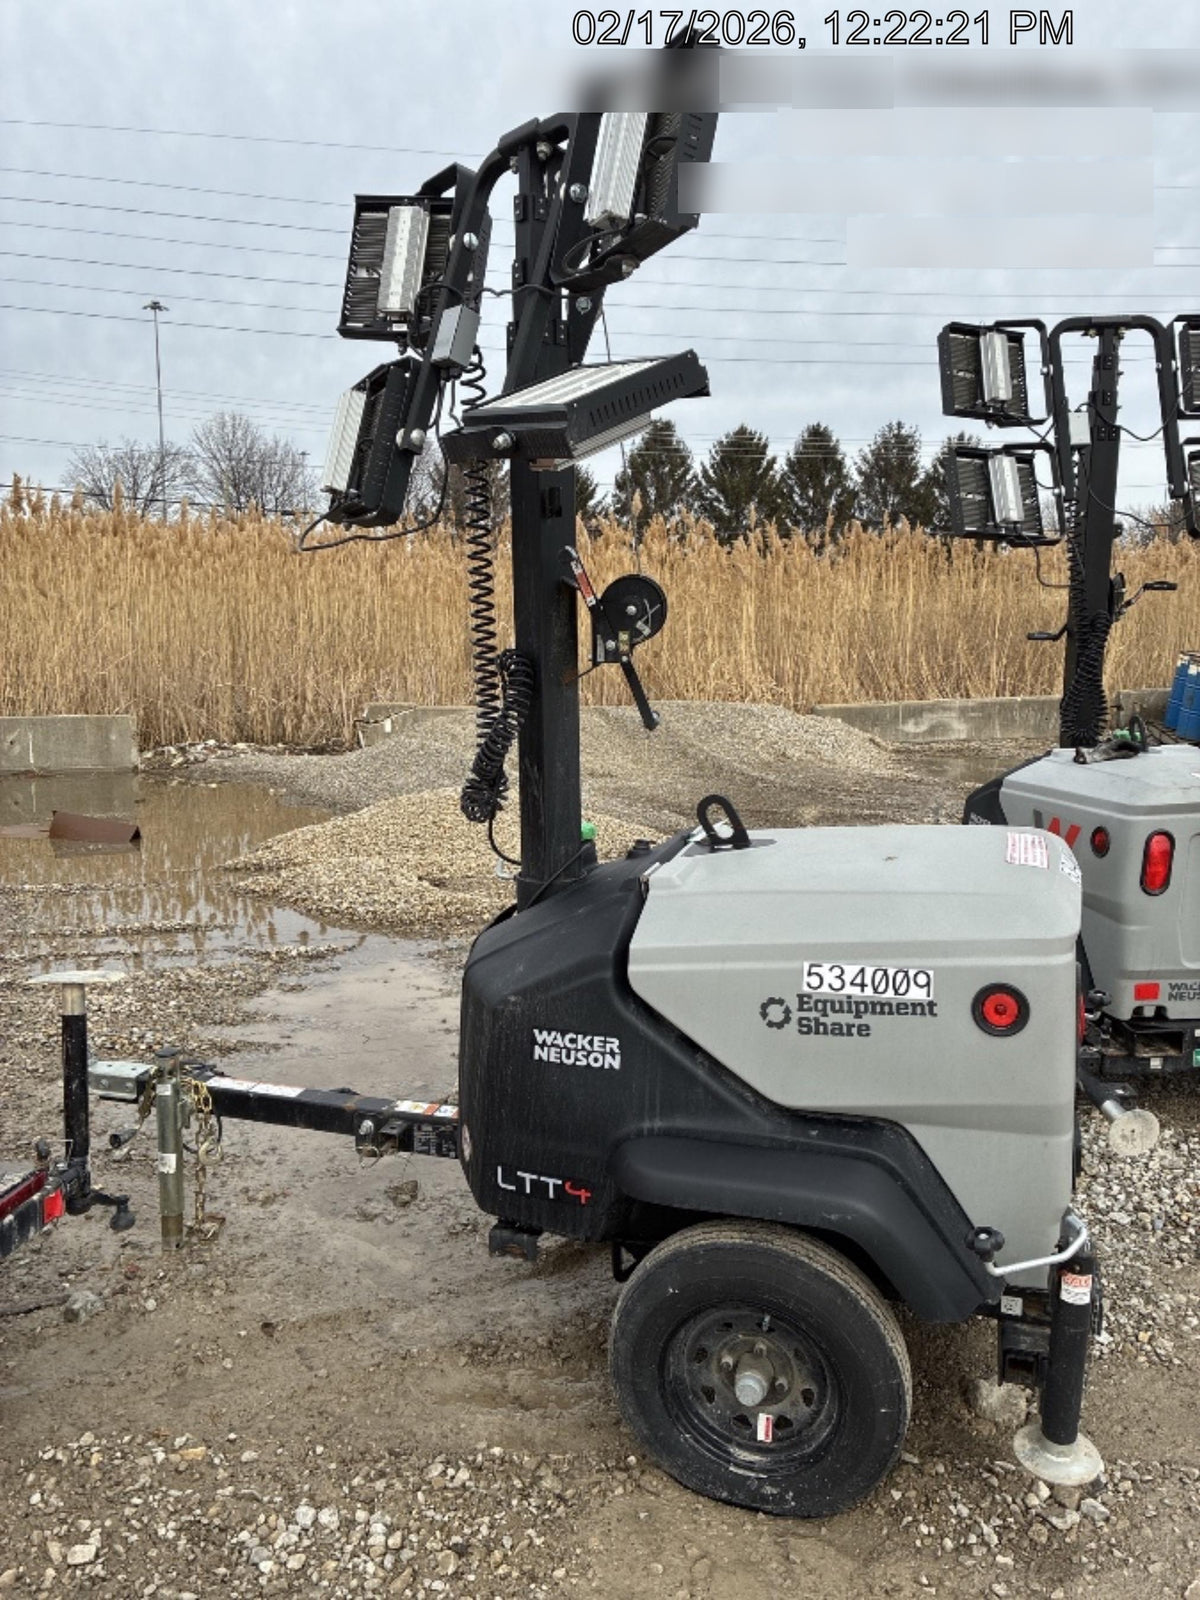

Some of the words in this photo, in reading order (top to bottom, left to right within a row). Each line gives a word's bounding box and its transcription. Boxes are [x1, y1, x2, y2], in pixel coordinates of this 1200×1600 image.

[805, 963, 932, 998] 534009
[1168, 981, 1200, 992] WAC
[796, 994, 938, 1019] Equipment
[797, 1016, 872, 1037] Share
[532, 1028, 621, 1053] WACKER
[533, 1047, 622, 1070] NEUSON
[496, 1165, 592, 1205] LTT4
